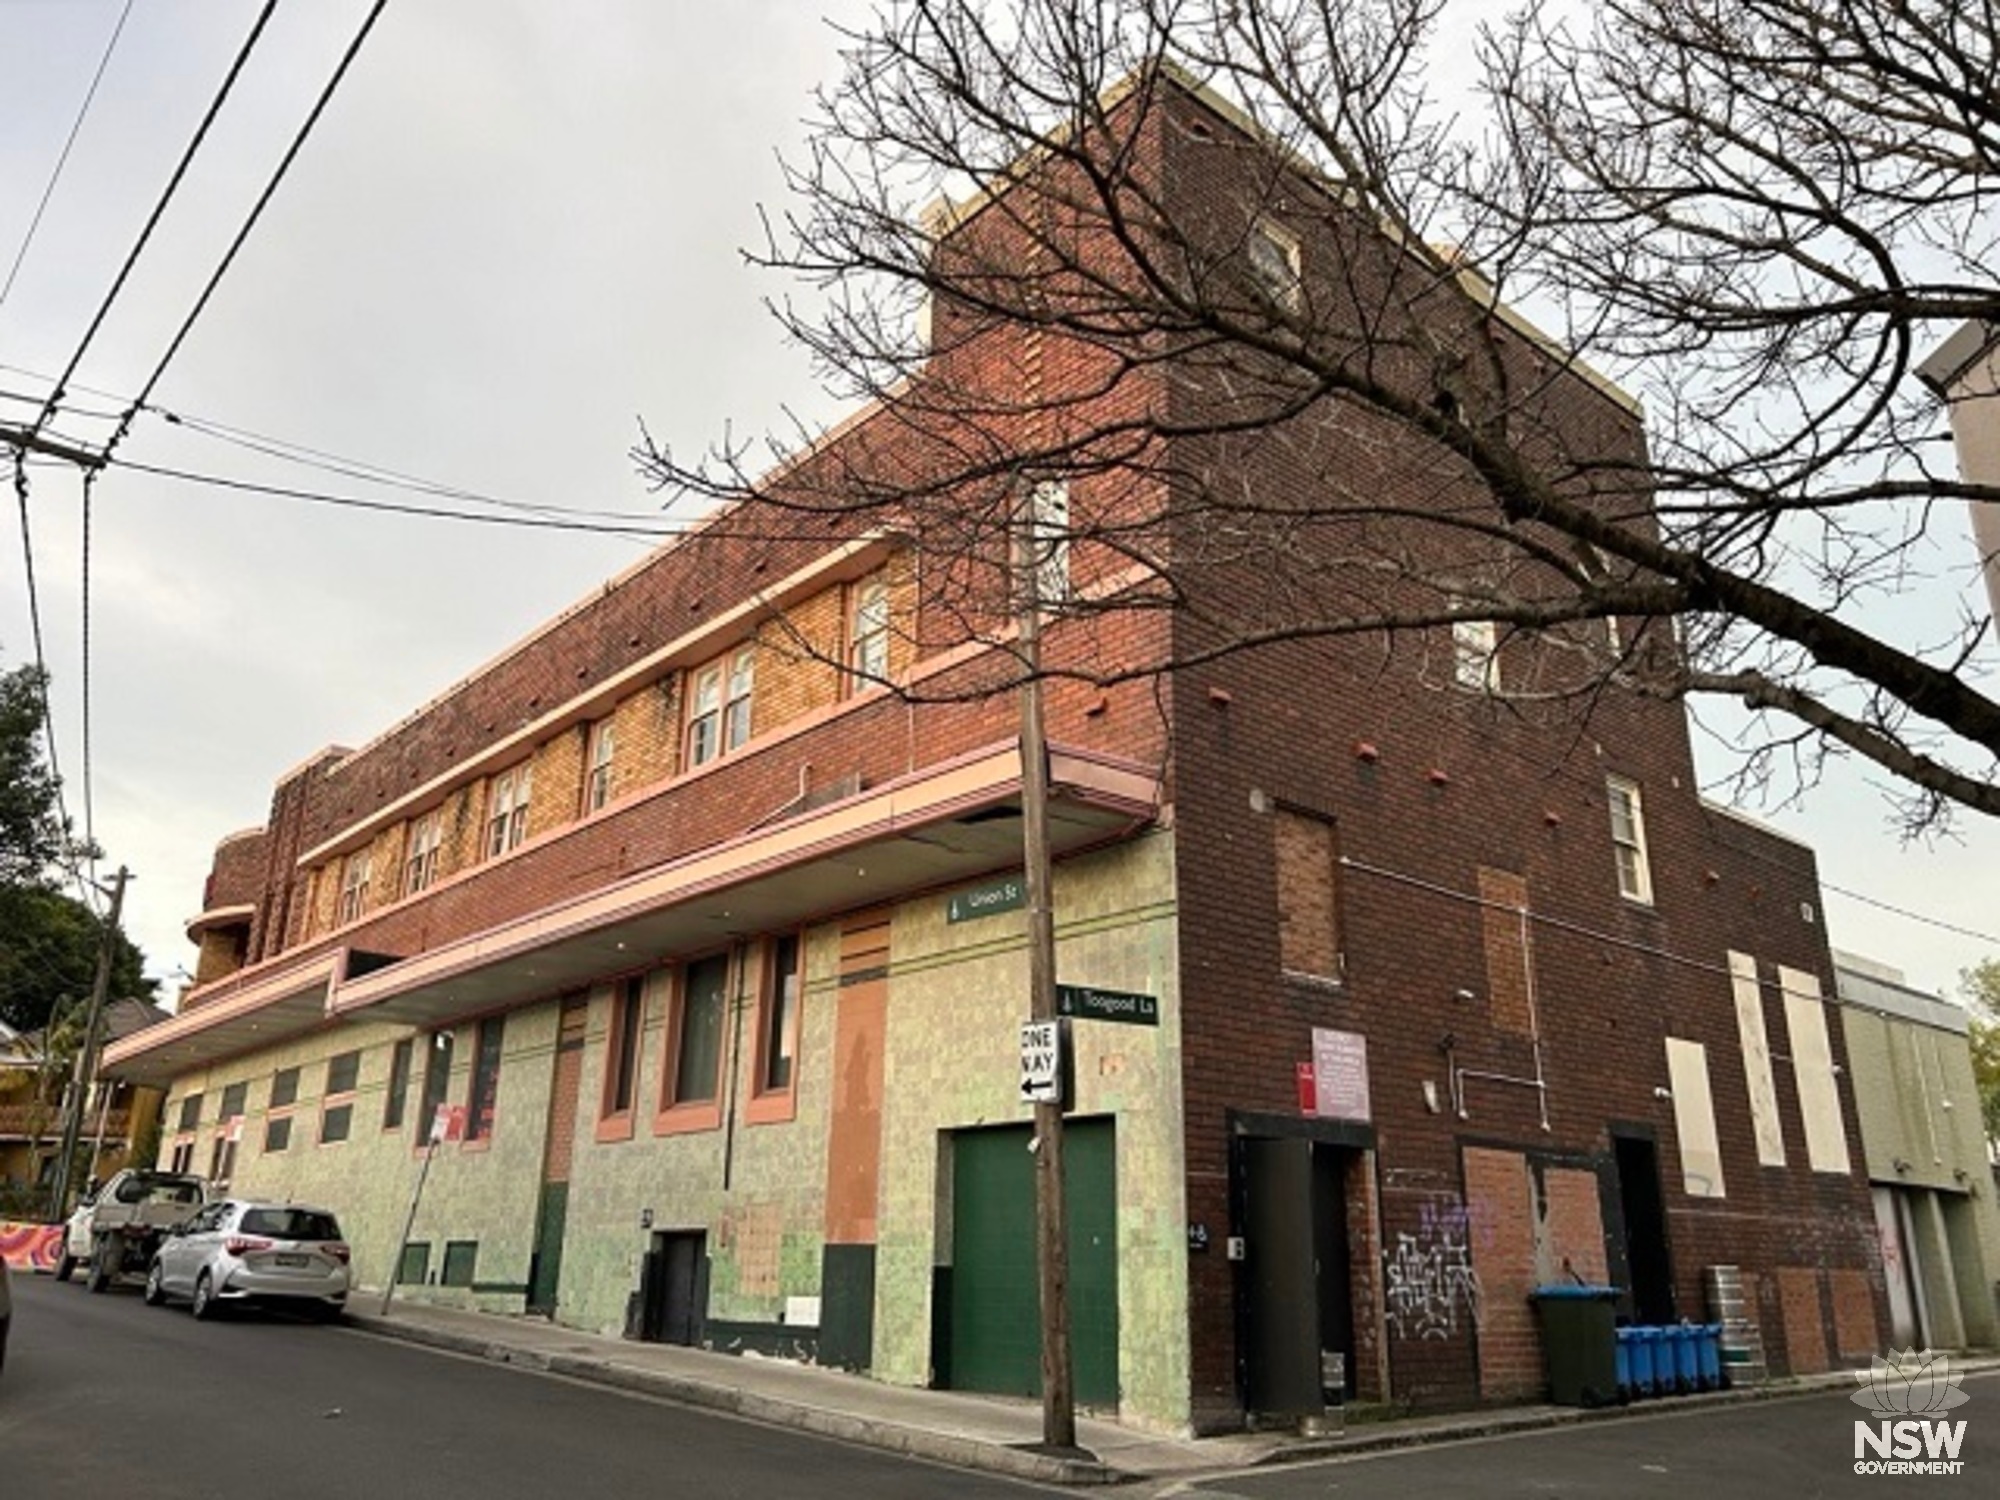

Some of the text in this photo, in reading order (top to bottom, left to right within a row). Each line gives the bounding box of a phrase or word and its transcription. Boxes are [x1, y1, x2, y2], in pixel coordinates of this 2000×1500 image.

[968, 884, 1017, 907] Union St
[1082, 989, 1154, 1014] Toogood La
